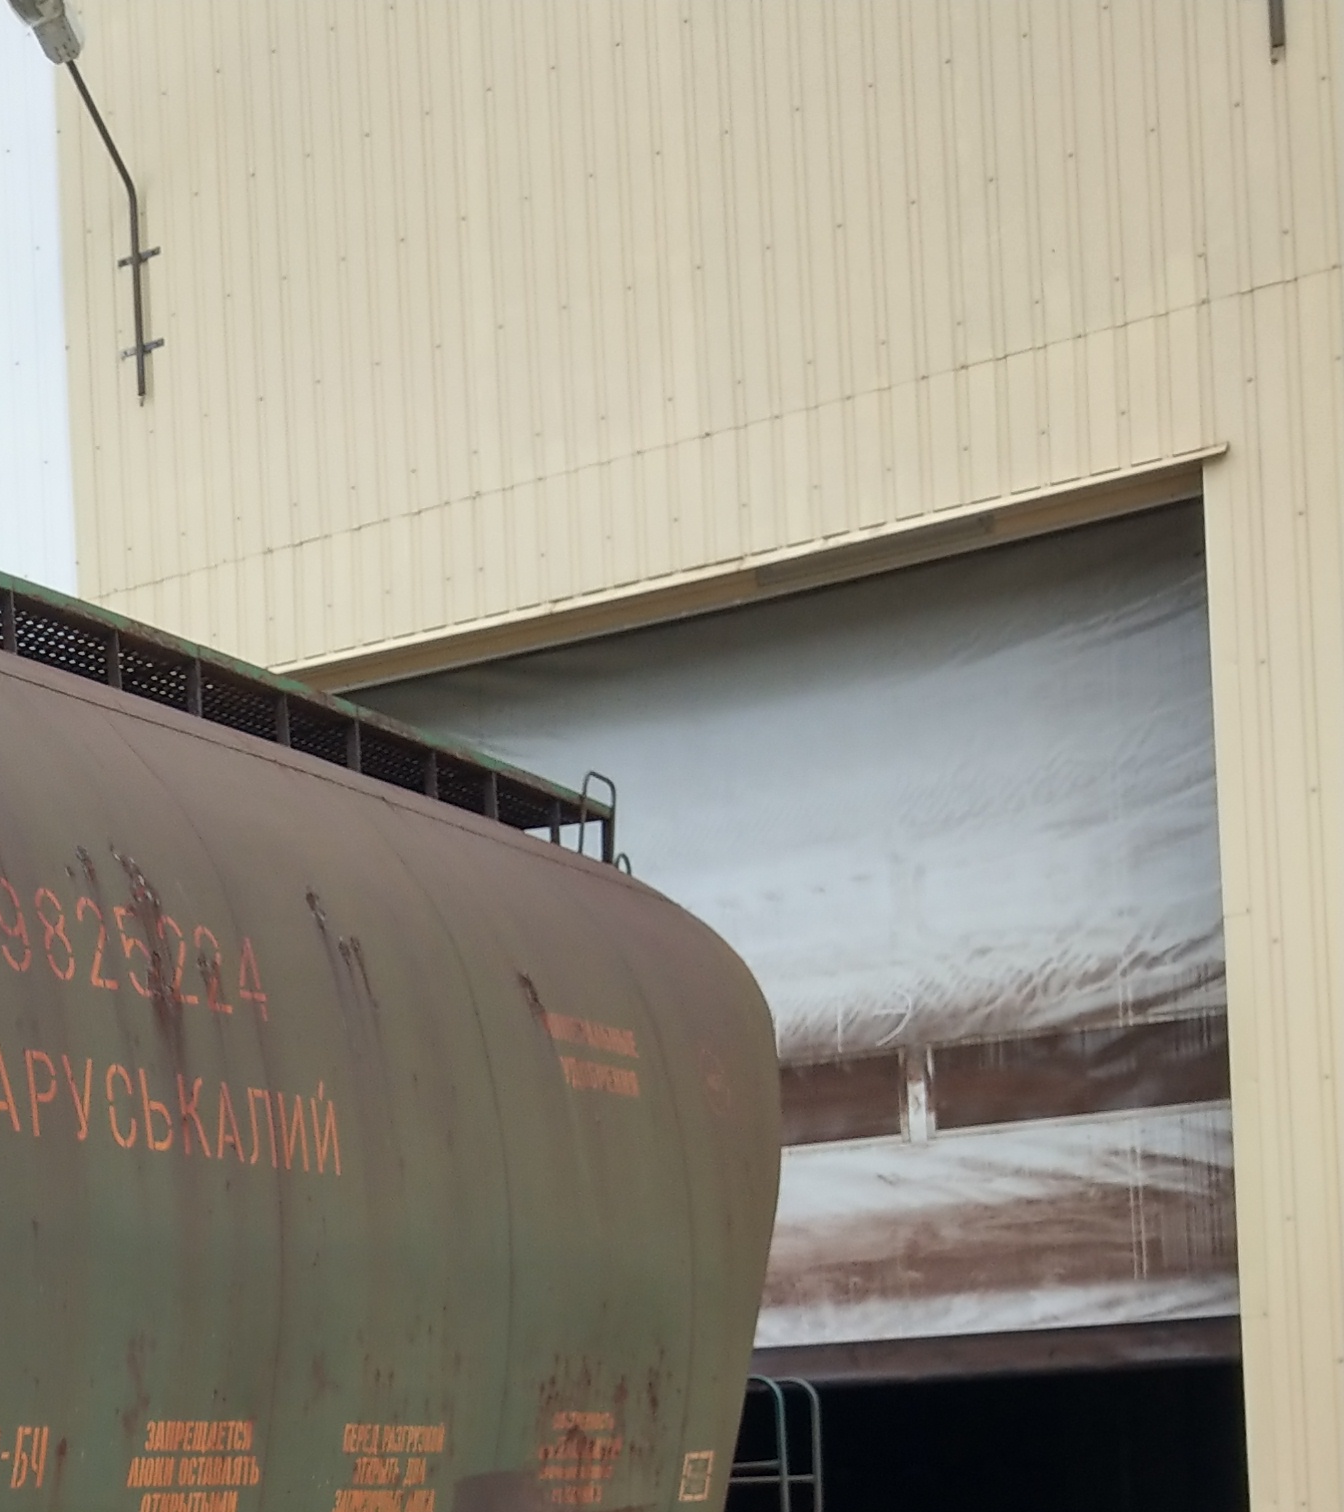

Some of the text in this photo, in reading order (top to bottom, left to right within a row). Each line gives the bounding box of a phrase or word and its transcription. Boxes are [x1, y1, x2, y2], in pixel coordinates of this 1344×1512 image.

[144, 1420, 254, 1454] ЗАПРЕЩАЕТСЯ
[126, 1455, 260, 1488] ЛЮКИ ОСТАВЛЯТЬ
